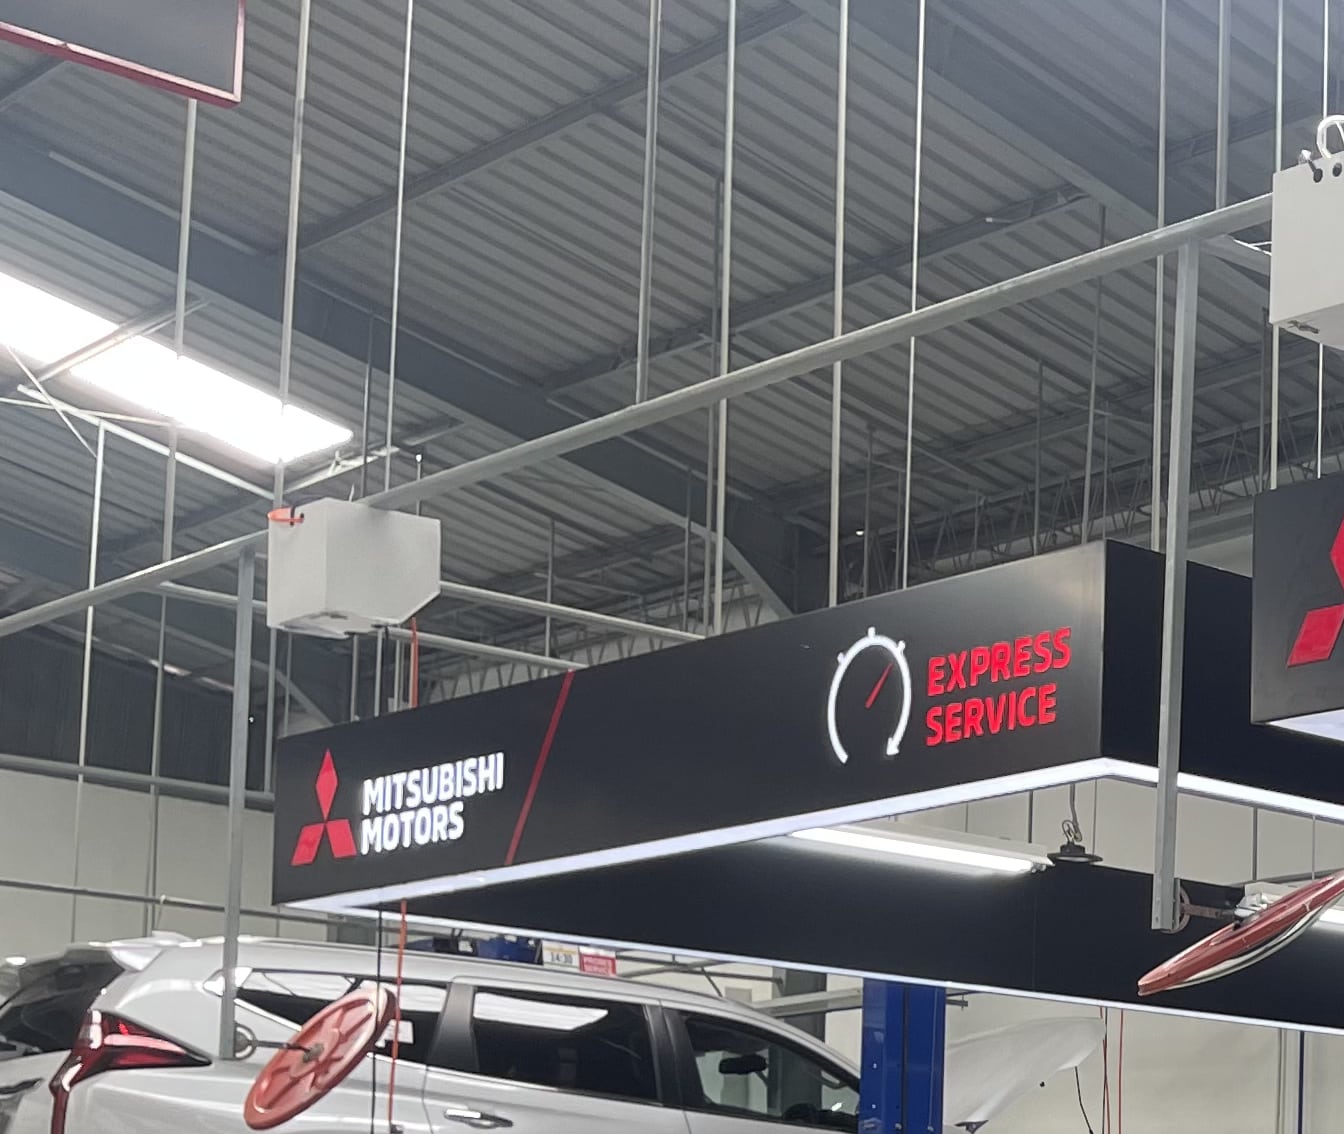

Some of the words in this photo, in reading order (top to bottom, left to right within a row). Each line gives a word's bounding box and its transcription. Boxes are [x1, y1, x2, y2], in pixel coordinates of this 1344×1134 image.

[927, 626, 1072, 697] EXPRESS
[925, 682, 1057, 747] SERVICE
[361, 752, 504, 816] MITSUBISHI
[360, 801, 464, 855] MOTORS
